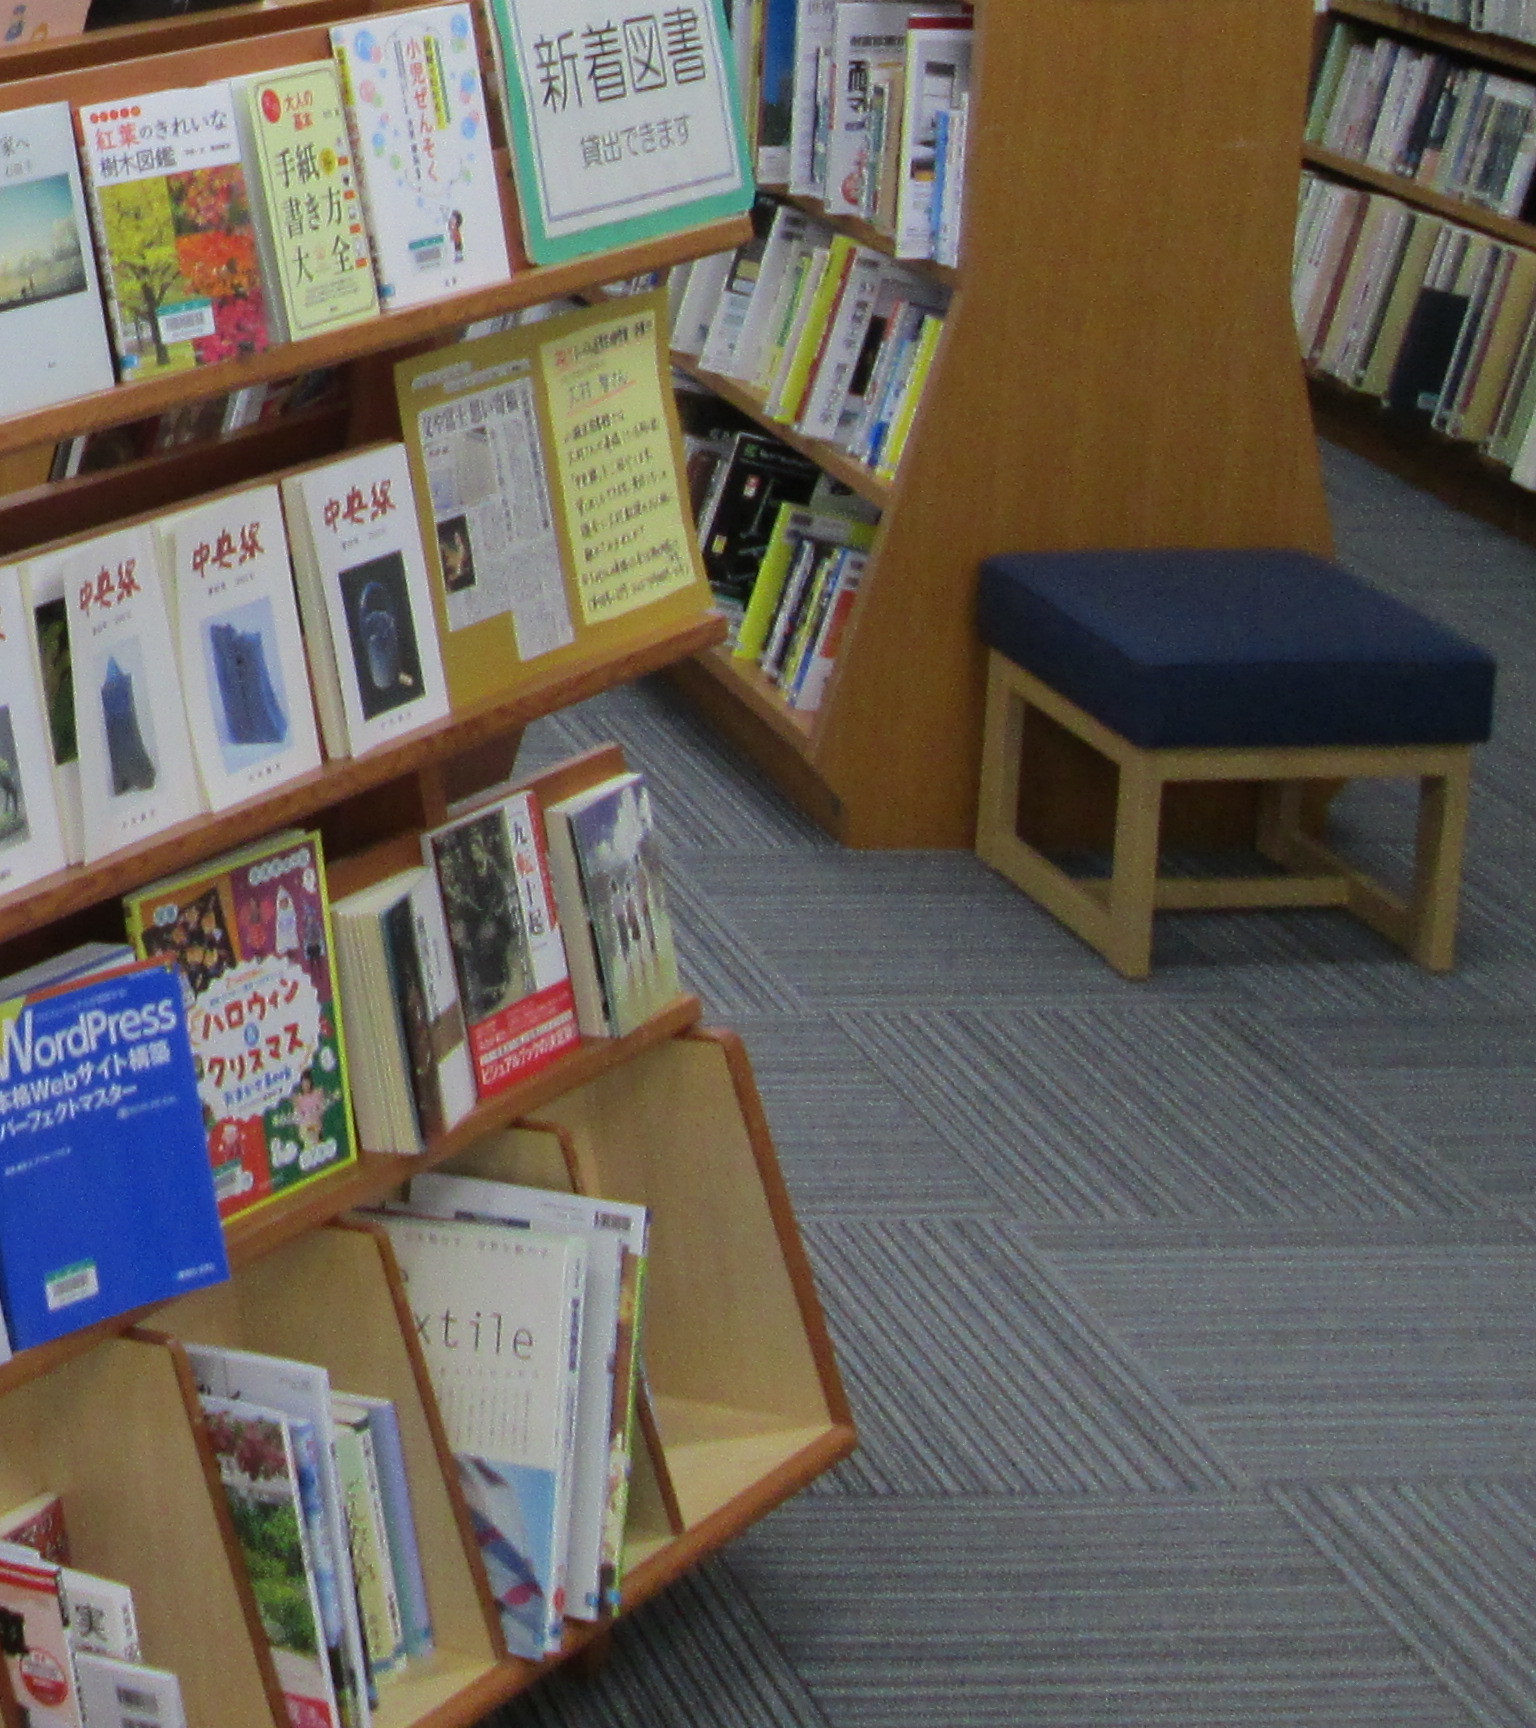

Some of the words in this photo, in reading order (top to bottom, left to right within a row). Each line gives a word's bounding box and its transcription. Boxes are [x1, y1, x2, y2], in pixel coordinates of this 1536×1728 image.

[533, 6, 707, 115] 新着図書
[94, 108, 229, 152] 紅葉のきれいな
[403, 34, 441, 183] 小児ぜんそく
[99, 147, 178, 179] 樹木図鑑
[274, 141, 321, 190] 手紙
[579, 113, 692, 170] 貸出できます
[284, 185, 344, 241] 書き方
[323, 478, 397, 532] 中央線
[191, 521, 266, 579] 中央線
[78, 556, 142, 616] 中央線
[200, 976, 300, 1042] ハロウィン
[205, 1021, 306, 1089] クリスマス
[74, 1603, 108, 1642] 実
